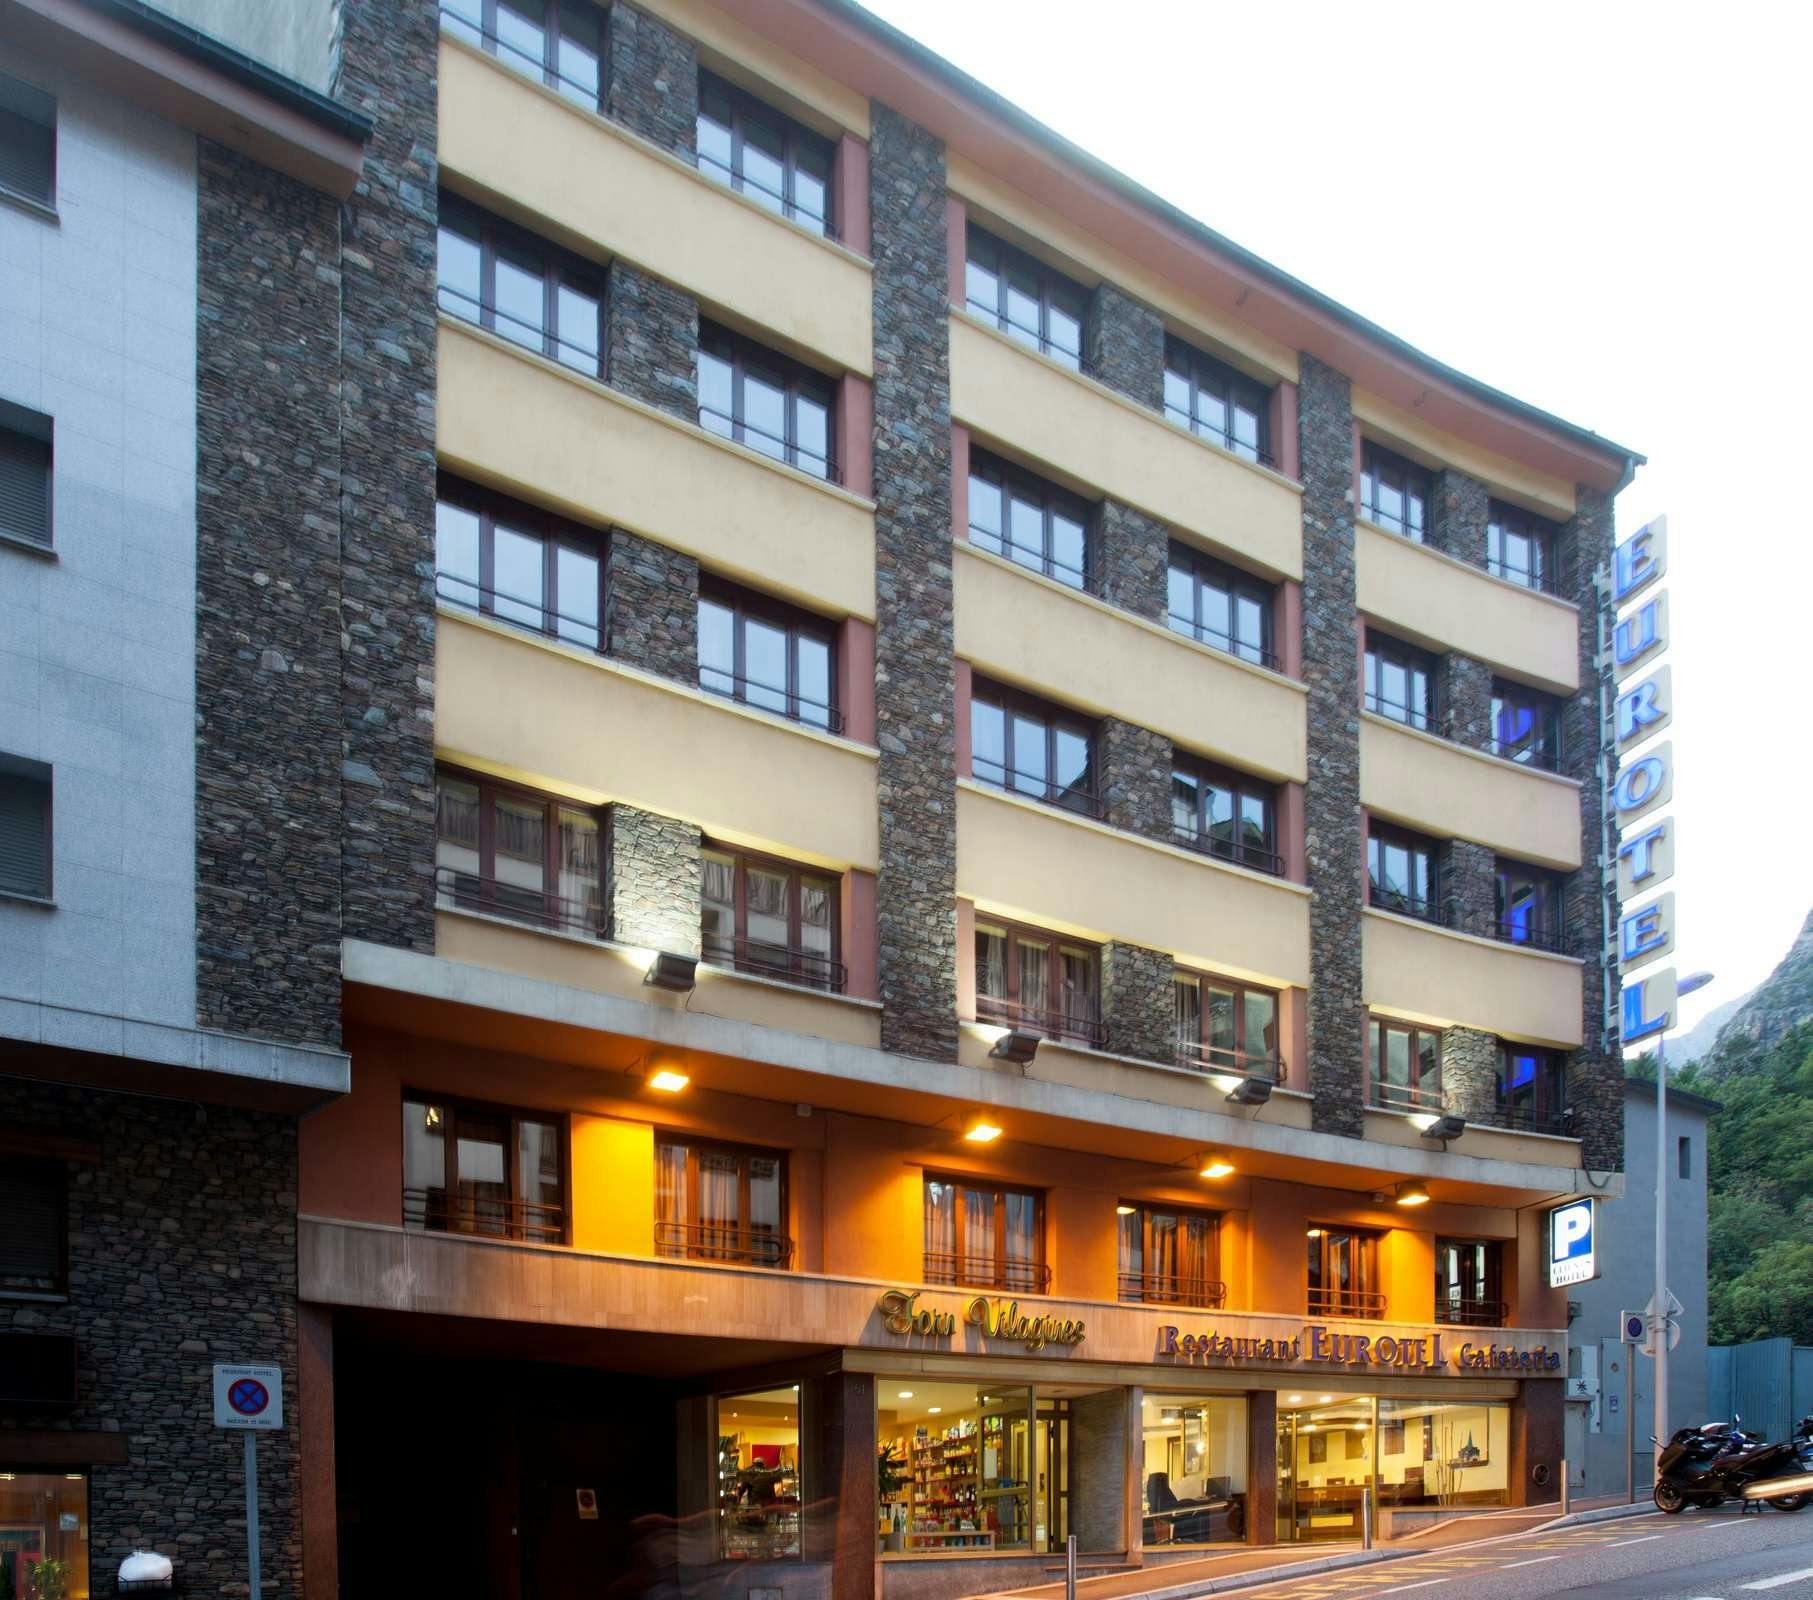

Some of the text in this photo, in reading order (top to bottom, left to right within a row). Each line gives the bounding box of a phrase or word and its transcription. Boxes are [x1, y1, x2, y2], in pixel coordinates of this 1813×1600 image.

[1613, 523, 1669, 1042] EUROTEL
[1555, 1206, 1591, 1260] P
[1556, 1269, 1588, 1284] HOTEL
[879, 1290, 1086, 1351] Forn Vilagines
[1160, 1326, 1561, 1369] Restaurant EUROTEL Cafeteria
